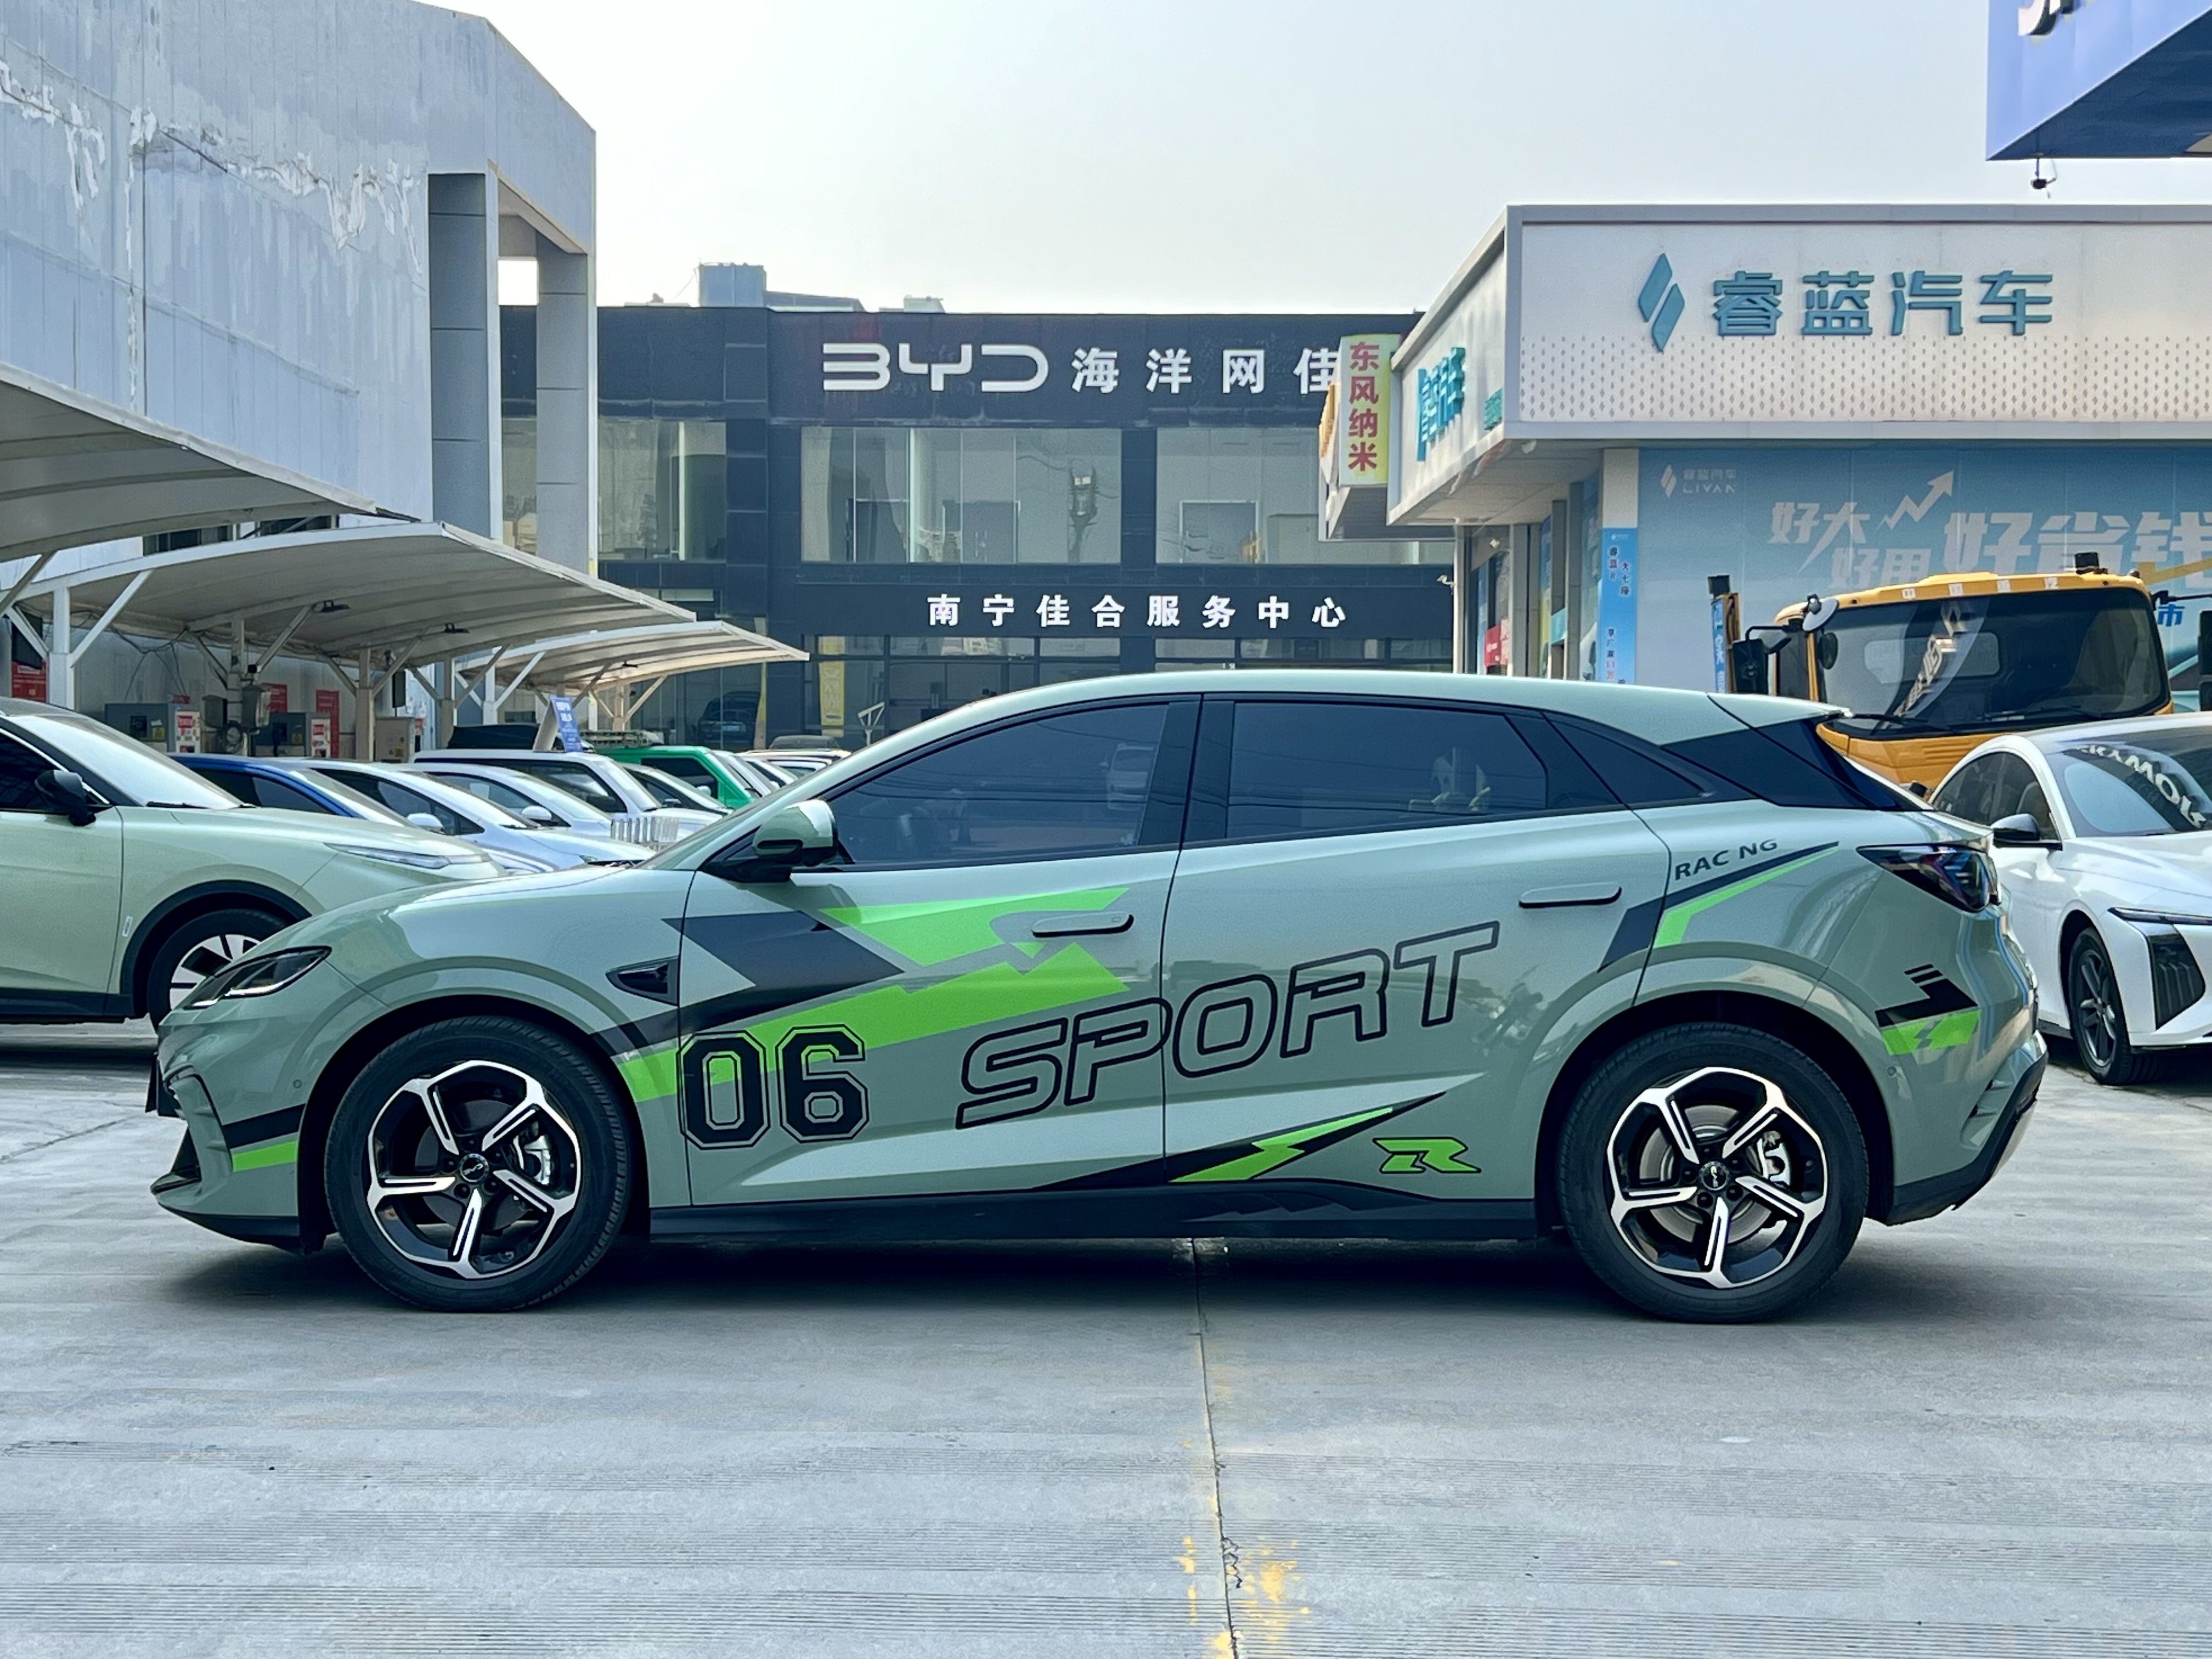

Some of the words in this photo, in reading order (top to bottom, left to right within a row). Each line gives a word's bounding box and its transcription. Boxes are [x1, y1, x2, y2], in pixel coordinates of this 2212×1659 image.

[1713, 270, 2053, 336] 睿蓝汽车
[822, 343, 1049, 392] BYD
[1071, 347, 1339, 394] 海洋网佳
[1348, 342, 1379, 471] 东风纳米
[927, 594, 1346, 629] 南宁佳合服务中心
[1675, 838, 1778, 881] RACNG
[956, 921, 1499, 1129] SPORT
[676, 1024, 870, 1149] 06
